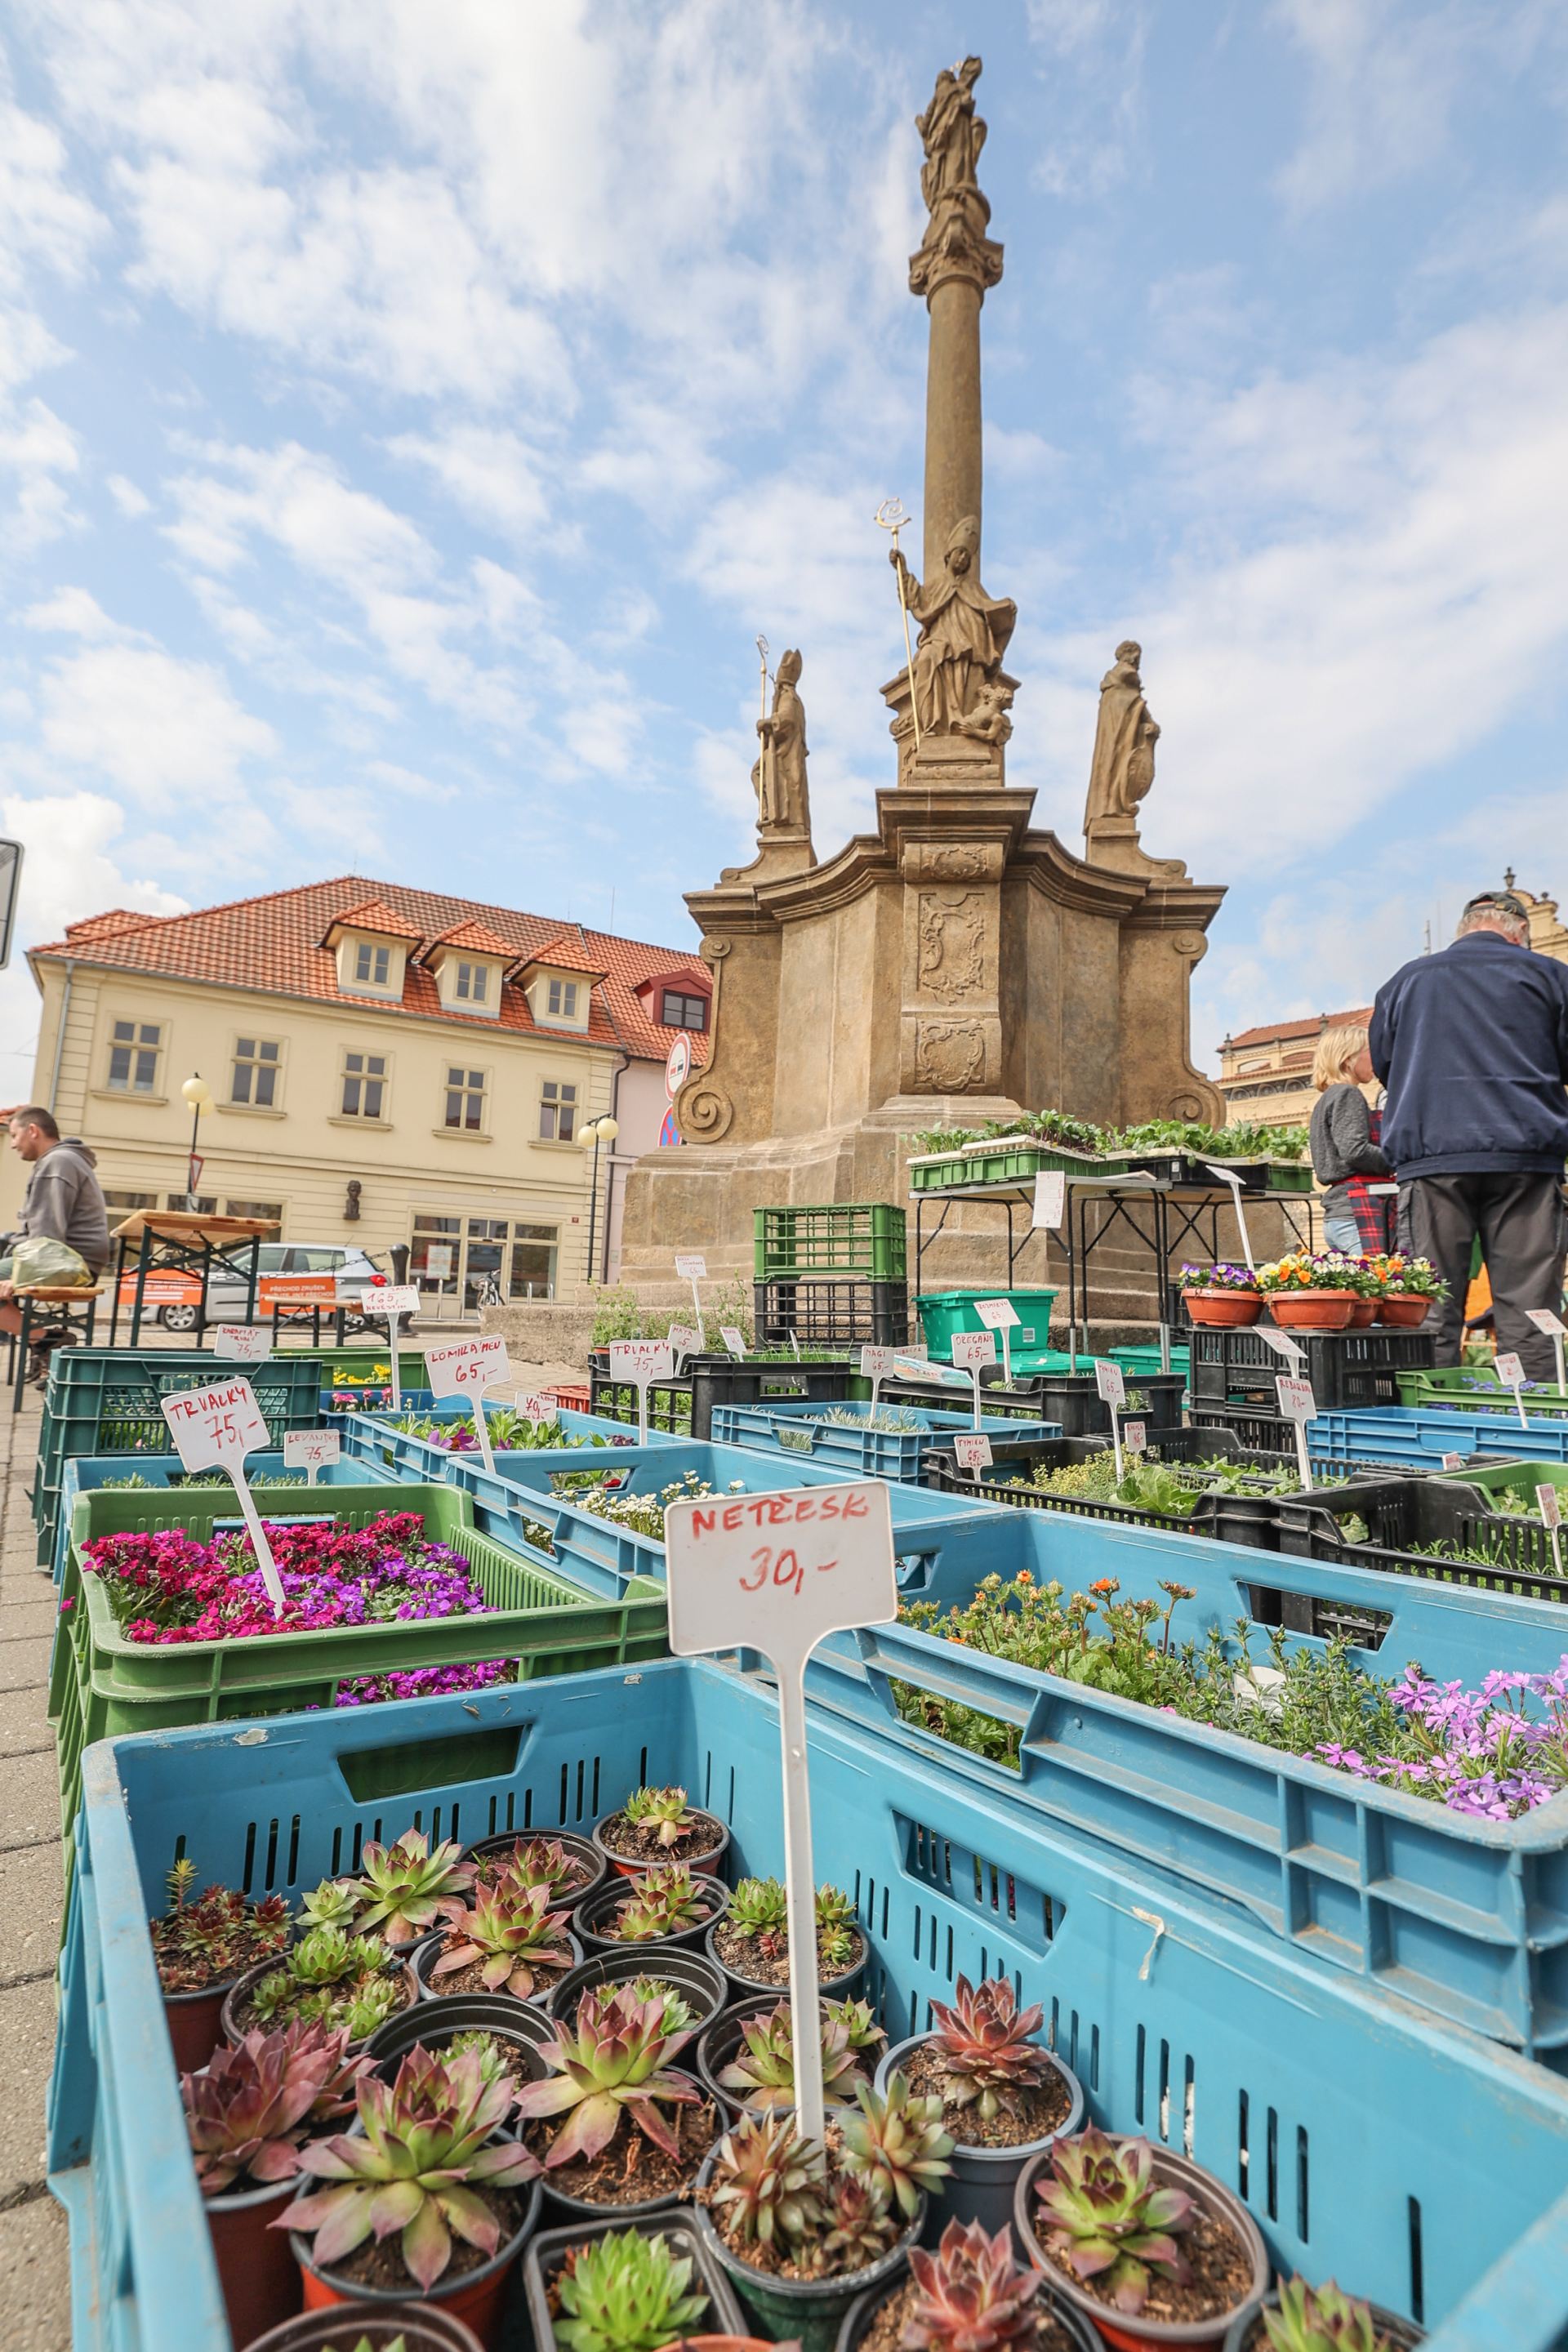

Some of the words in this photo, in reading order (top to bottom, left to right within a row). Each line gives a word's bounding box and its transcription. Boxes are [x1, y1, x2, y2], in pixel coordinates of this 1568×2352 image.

[169, 1386, 247, 1421] TRVALKY
[204, 1413, 258, 1449] 75,-
[692, 1494, 869, 1539] NETŘESK
[740, 1546, 839, 1596] 30,-
